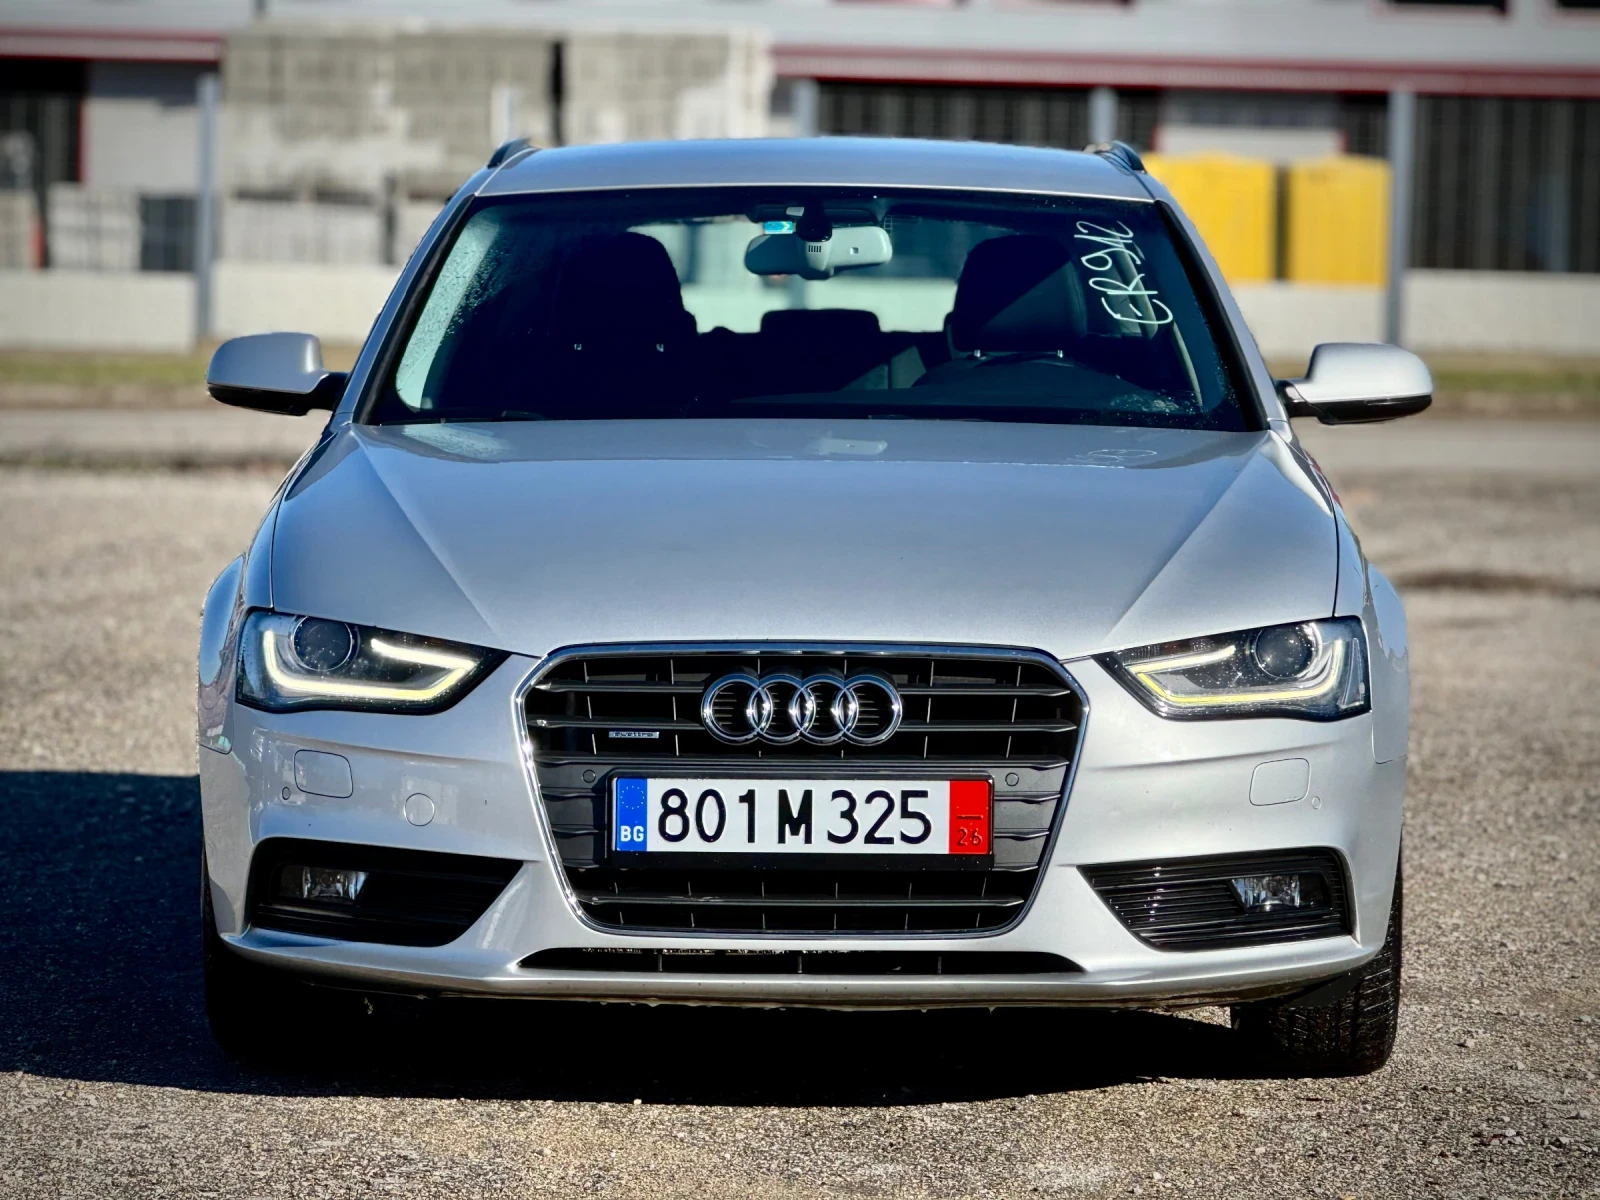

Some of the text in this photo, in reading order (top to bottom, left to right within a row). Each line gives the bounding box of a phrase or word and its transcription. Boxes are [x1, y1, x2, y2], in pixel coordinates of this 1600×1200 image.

[658, 788, 932, 844] 801 M 325
[620, 825, 645, 842] BG
[957, 827, 983, 847] 26
